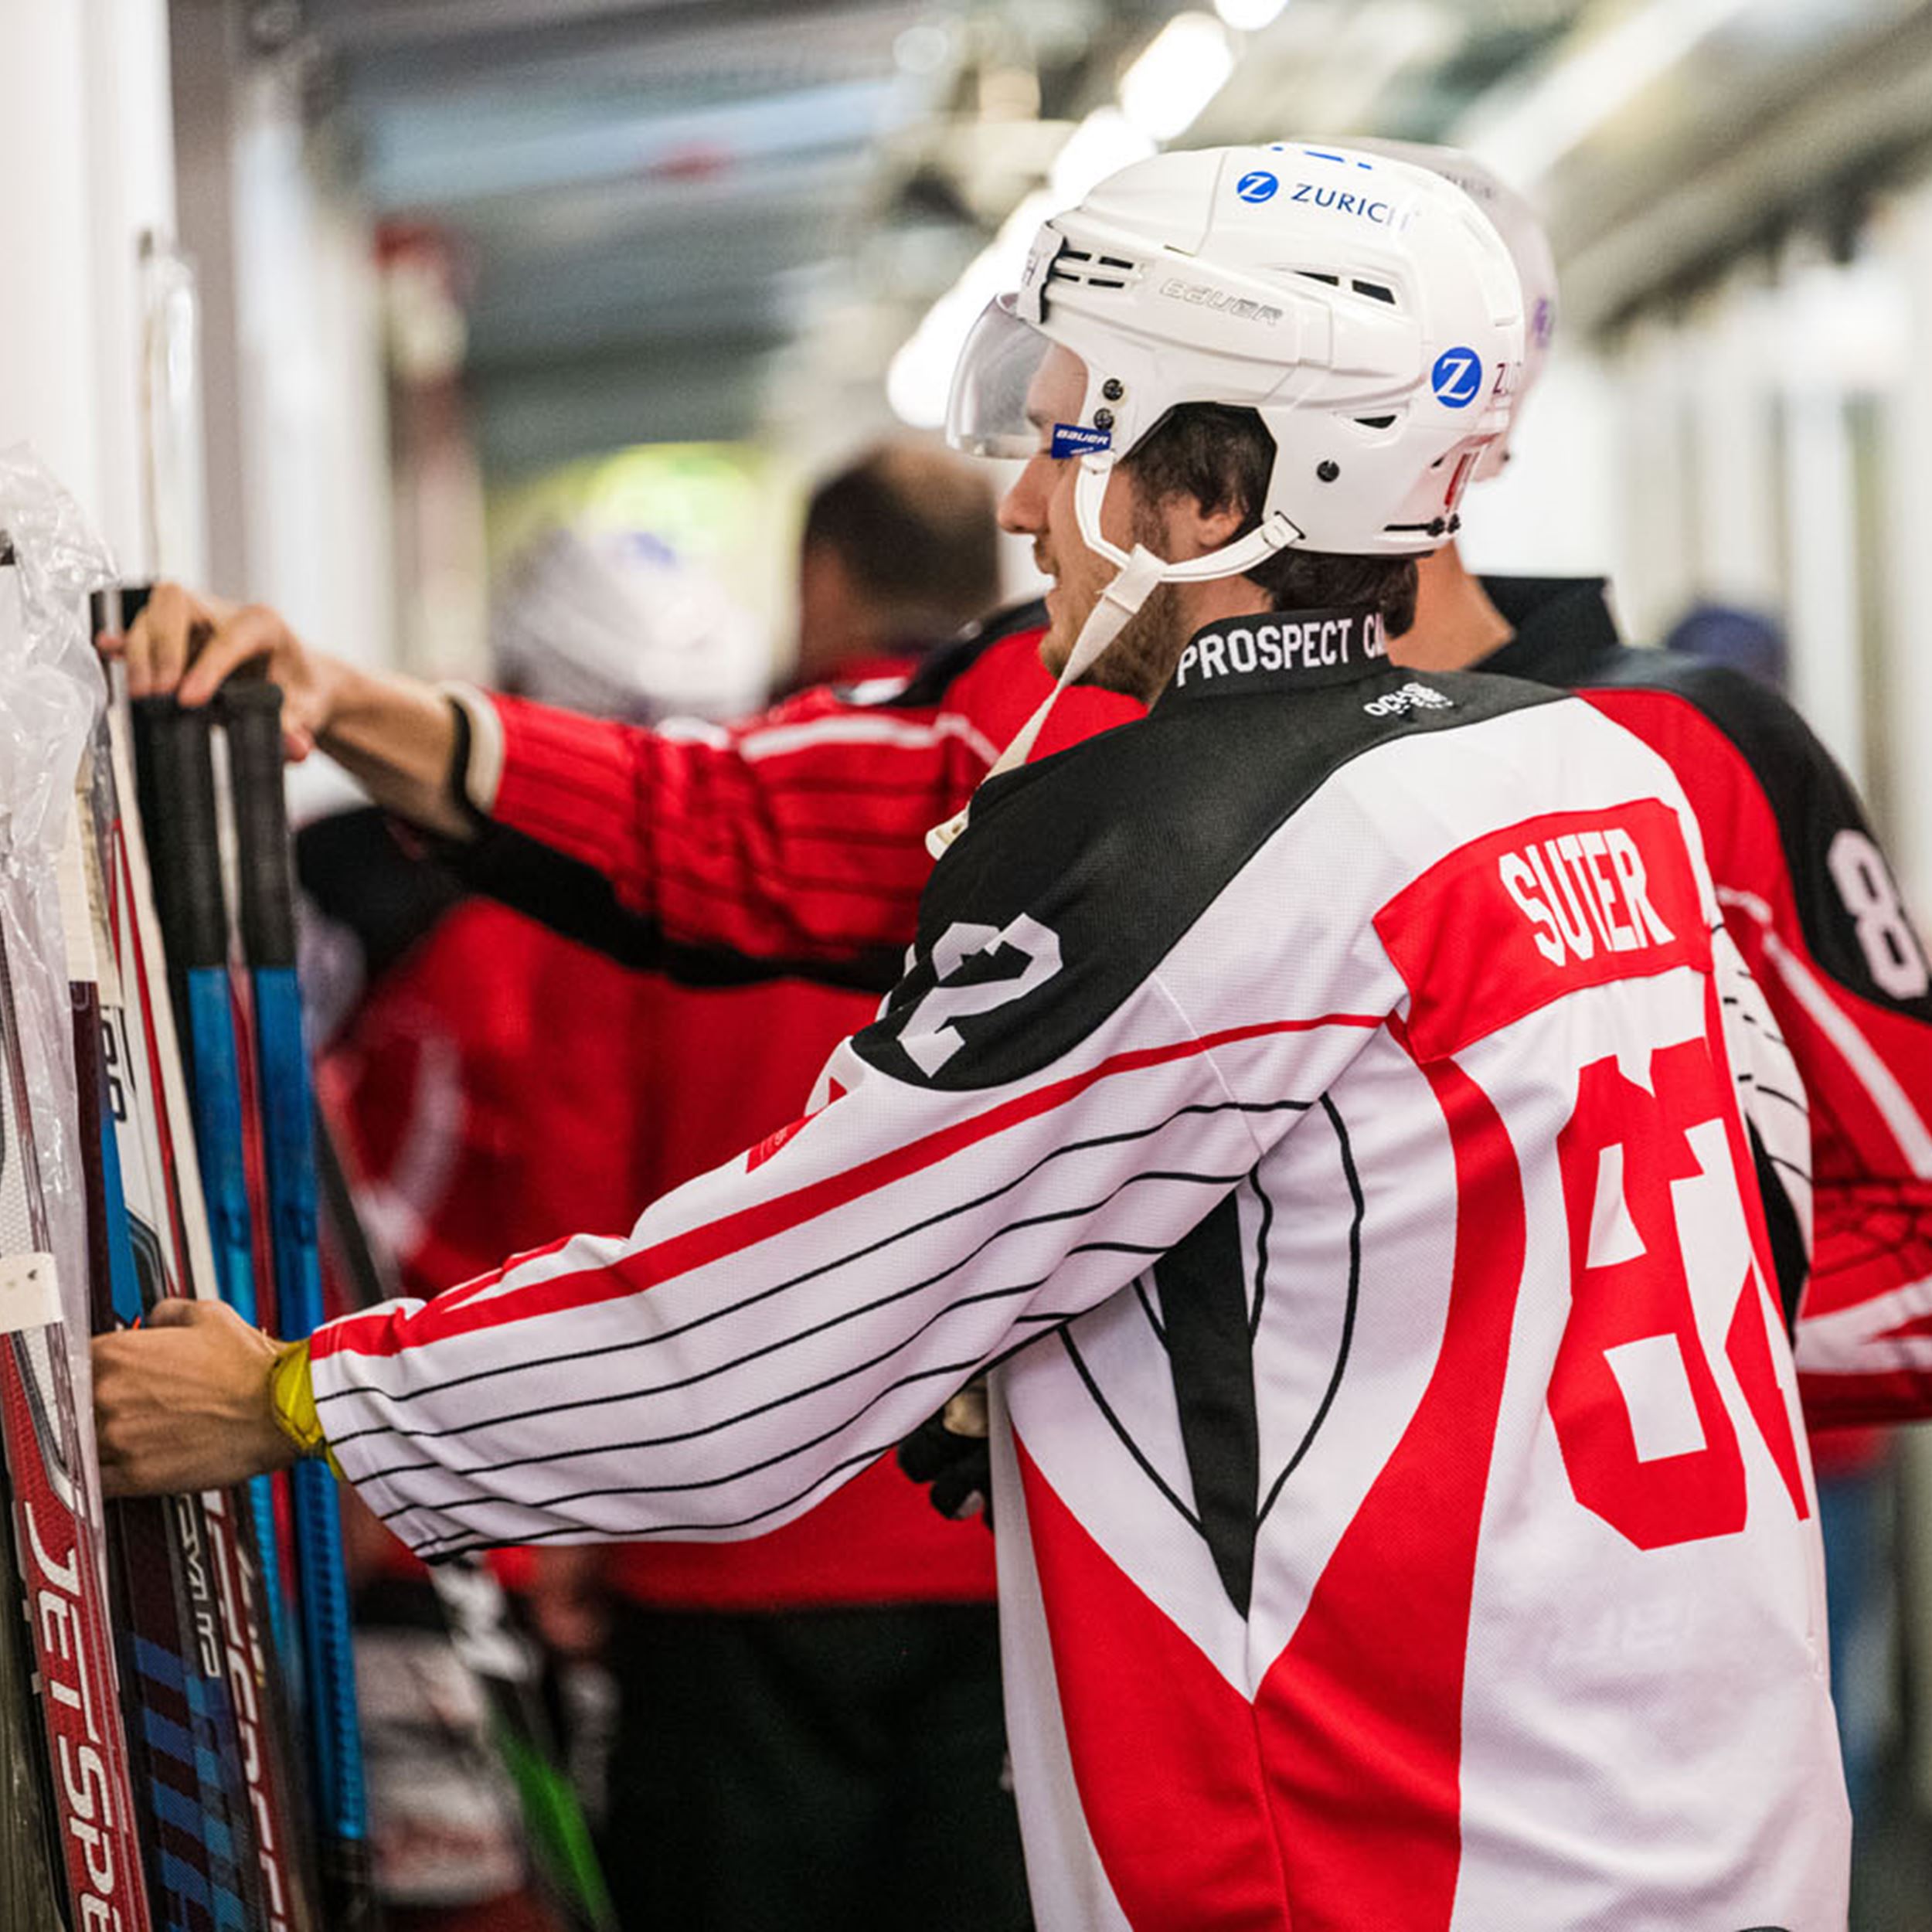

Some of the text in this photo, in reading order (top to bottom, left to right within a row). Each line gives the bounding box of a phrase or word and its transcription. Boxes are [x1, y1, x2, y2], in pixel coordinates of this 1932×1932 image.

[1176, 618, 1353, 688] PROSPECT
[1498, 828, 1676, 967] SUTER
[1827, 829, 1929, 1000] 8
[876, 912, 1063, 1080] 2
